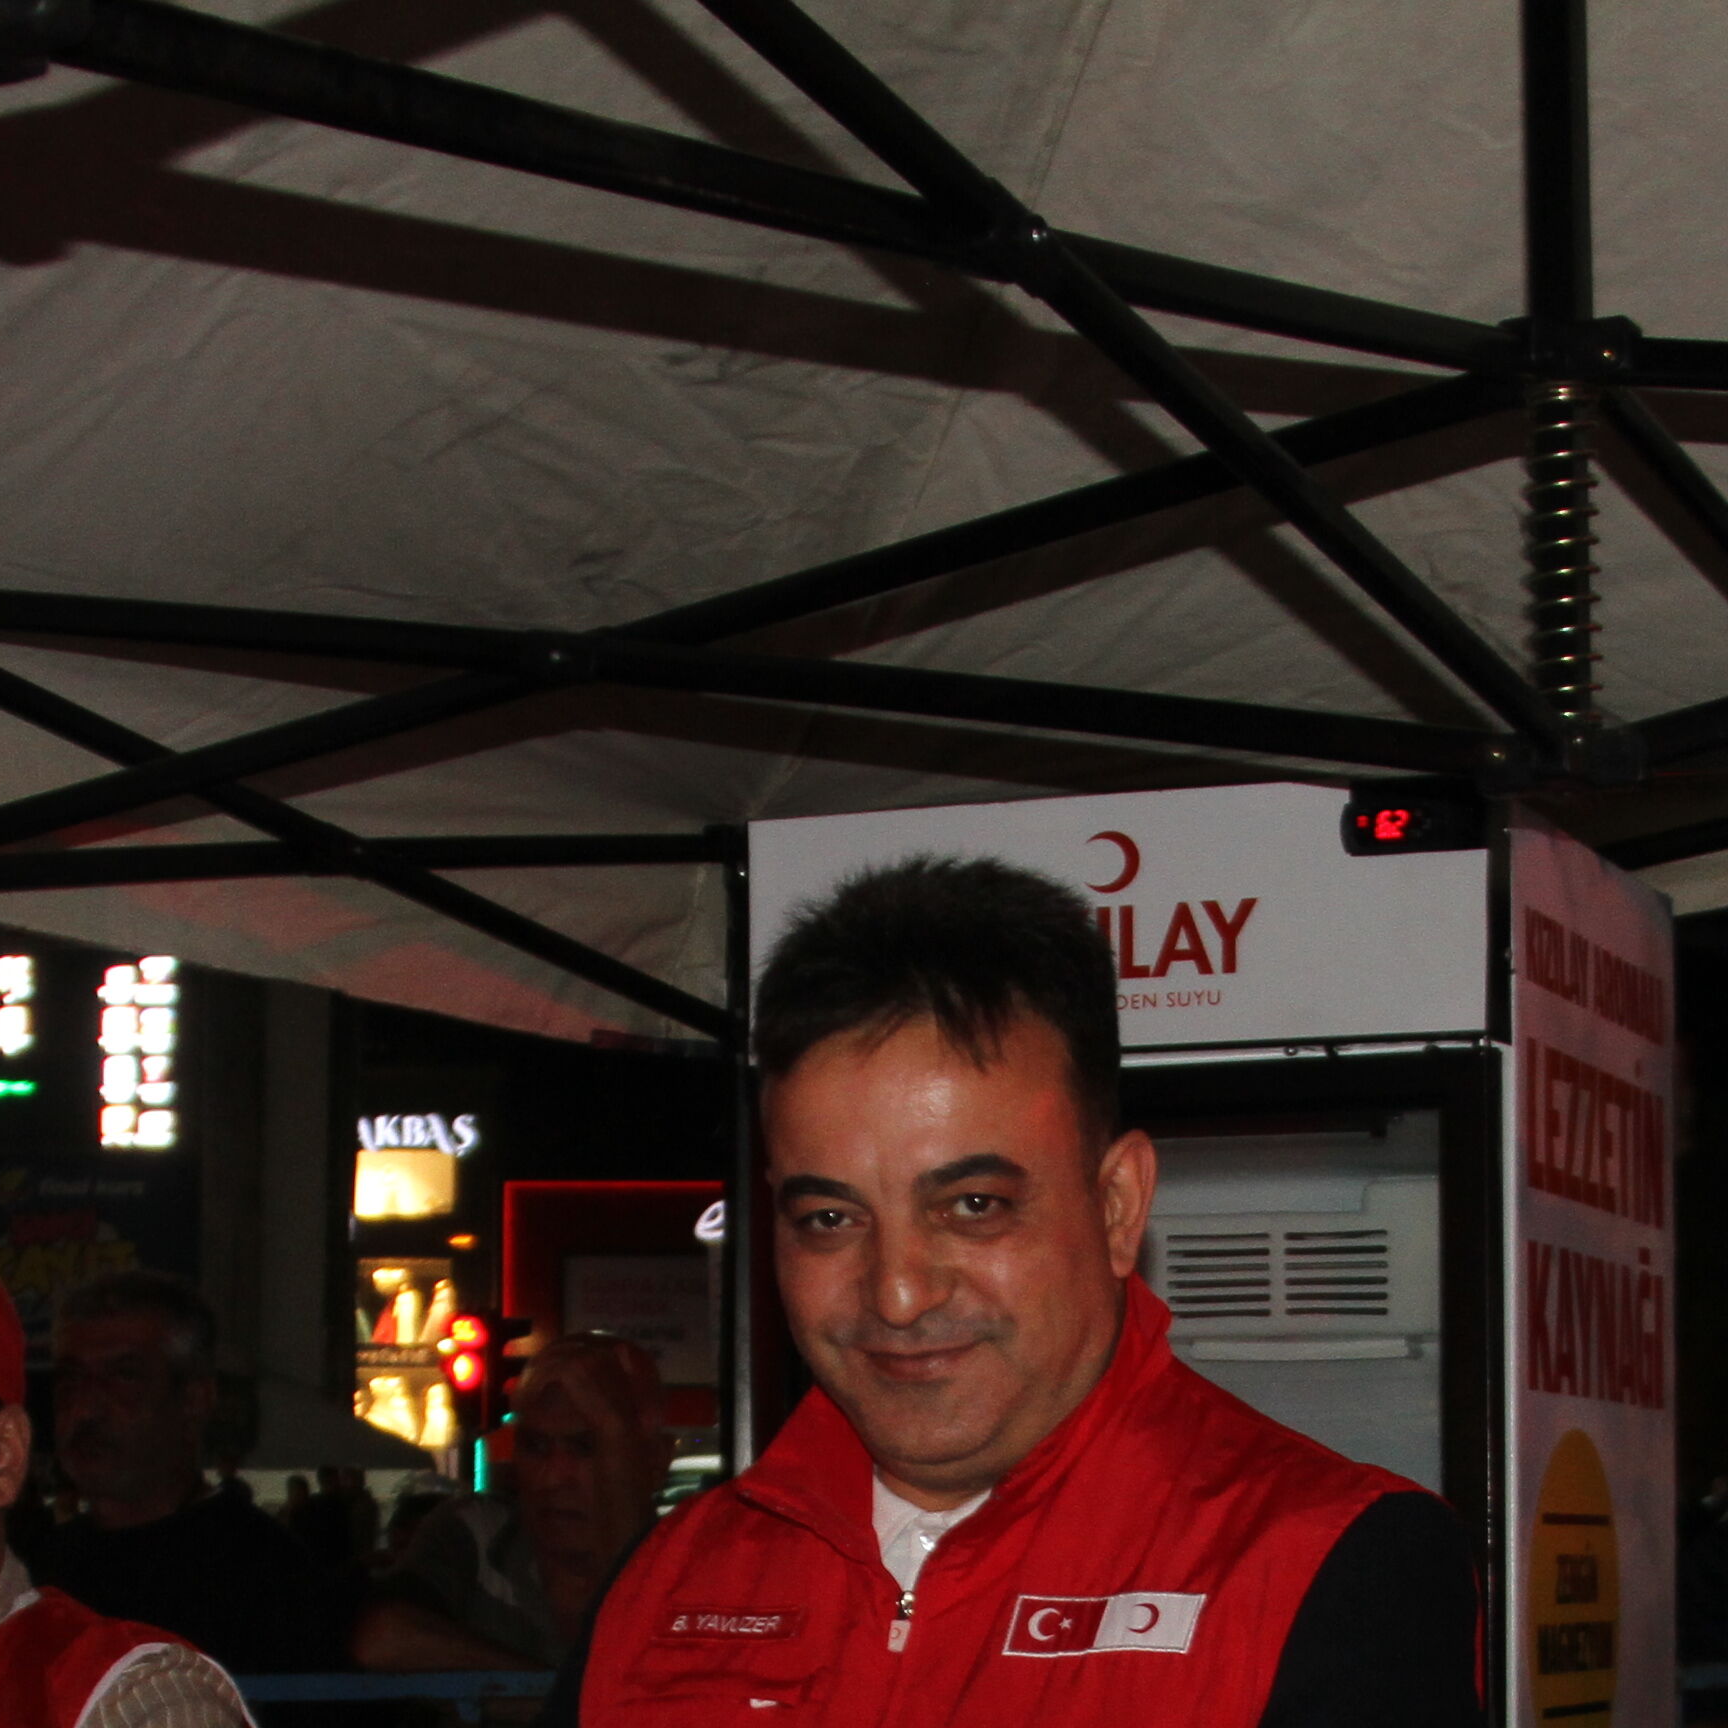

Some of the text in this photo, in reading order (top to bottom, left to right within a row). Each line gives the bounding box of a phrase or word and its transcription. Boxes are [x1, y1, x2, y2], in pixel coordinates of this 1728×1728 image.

[1115, 990, 1221, 1011] DEN SUYU
[1527, 1036, 1665, 1230] LEZZETİN
[1527, 1239, 1665, 1410] KAYNAĞI
[696, 1613, 780, 1633] YAVUZER
